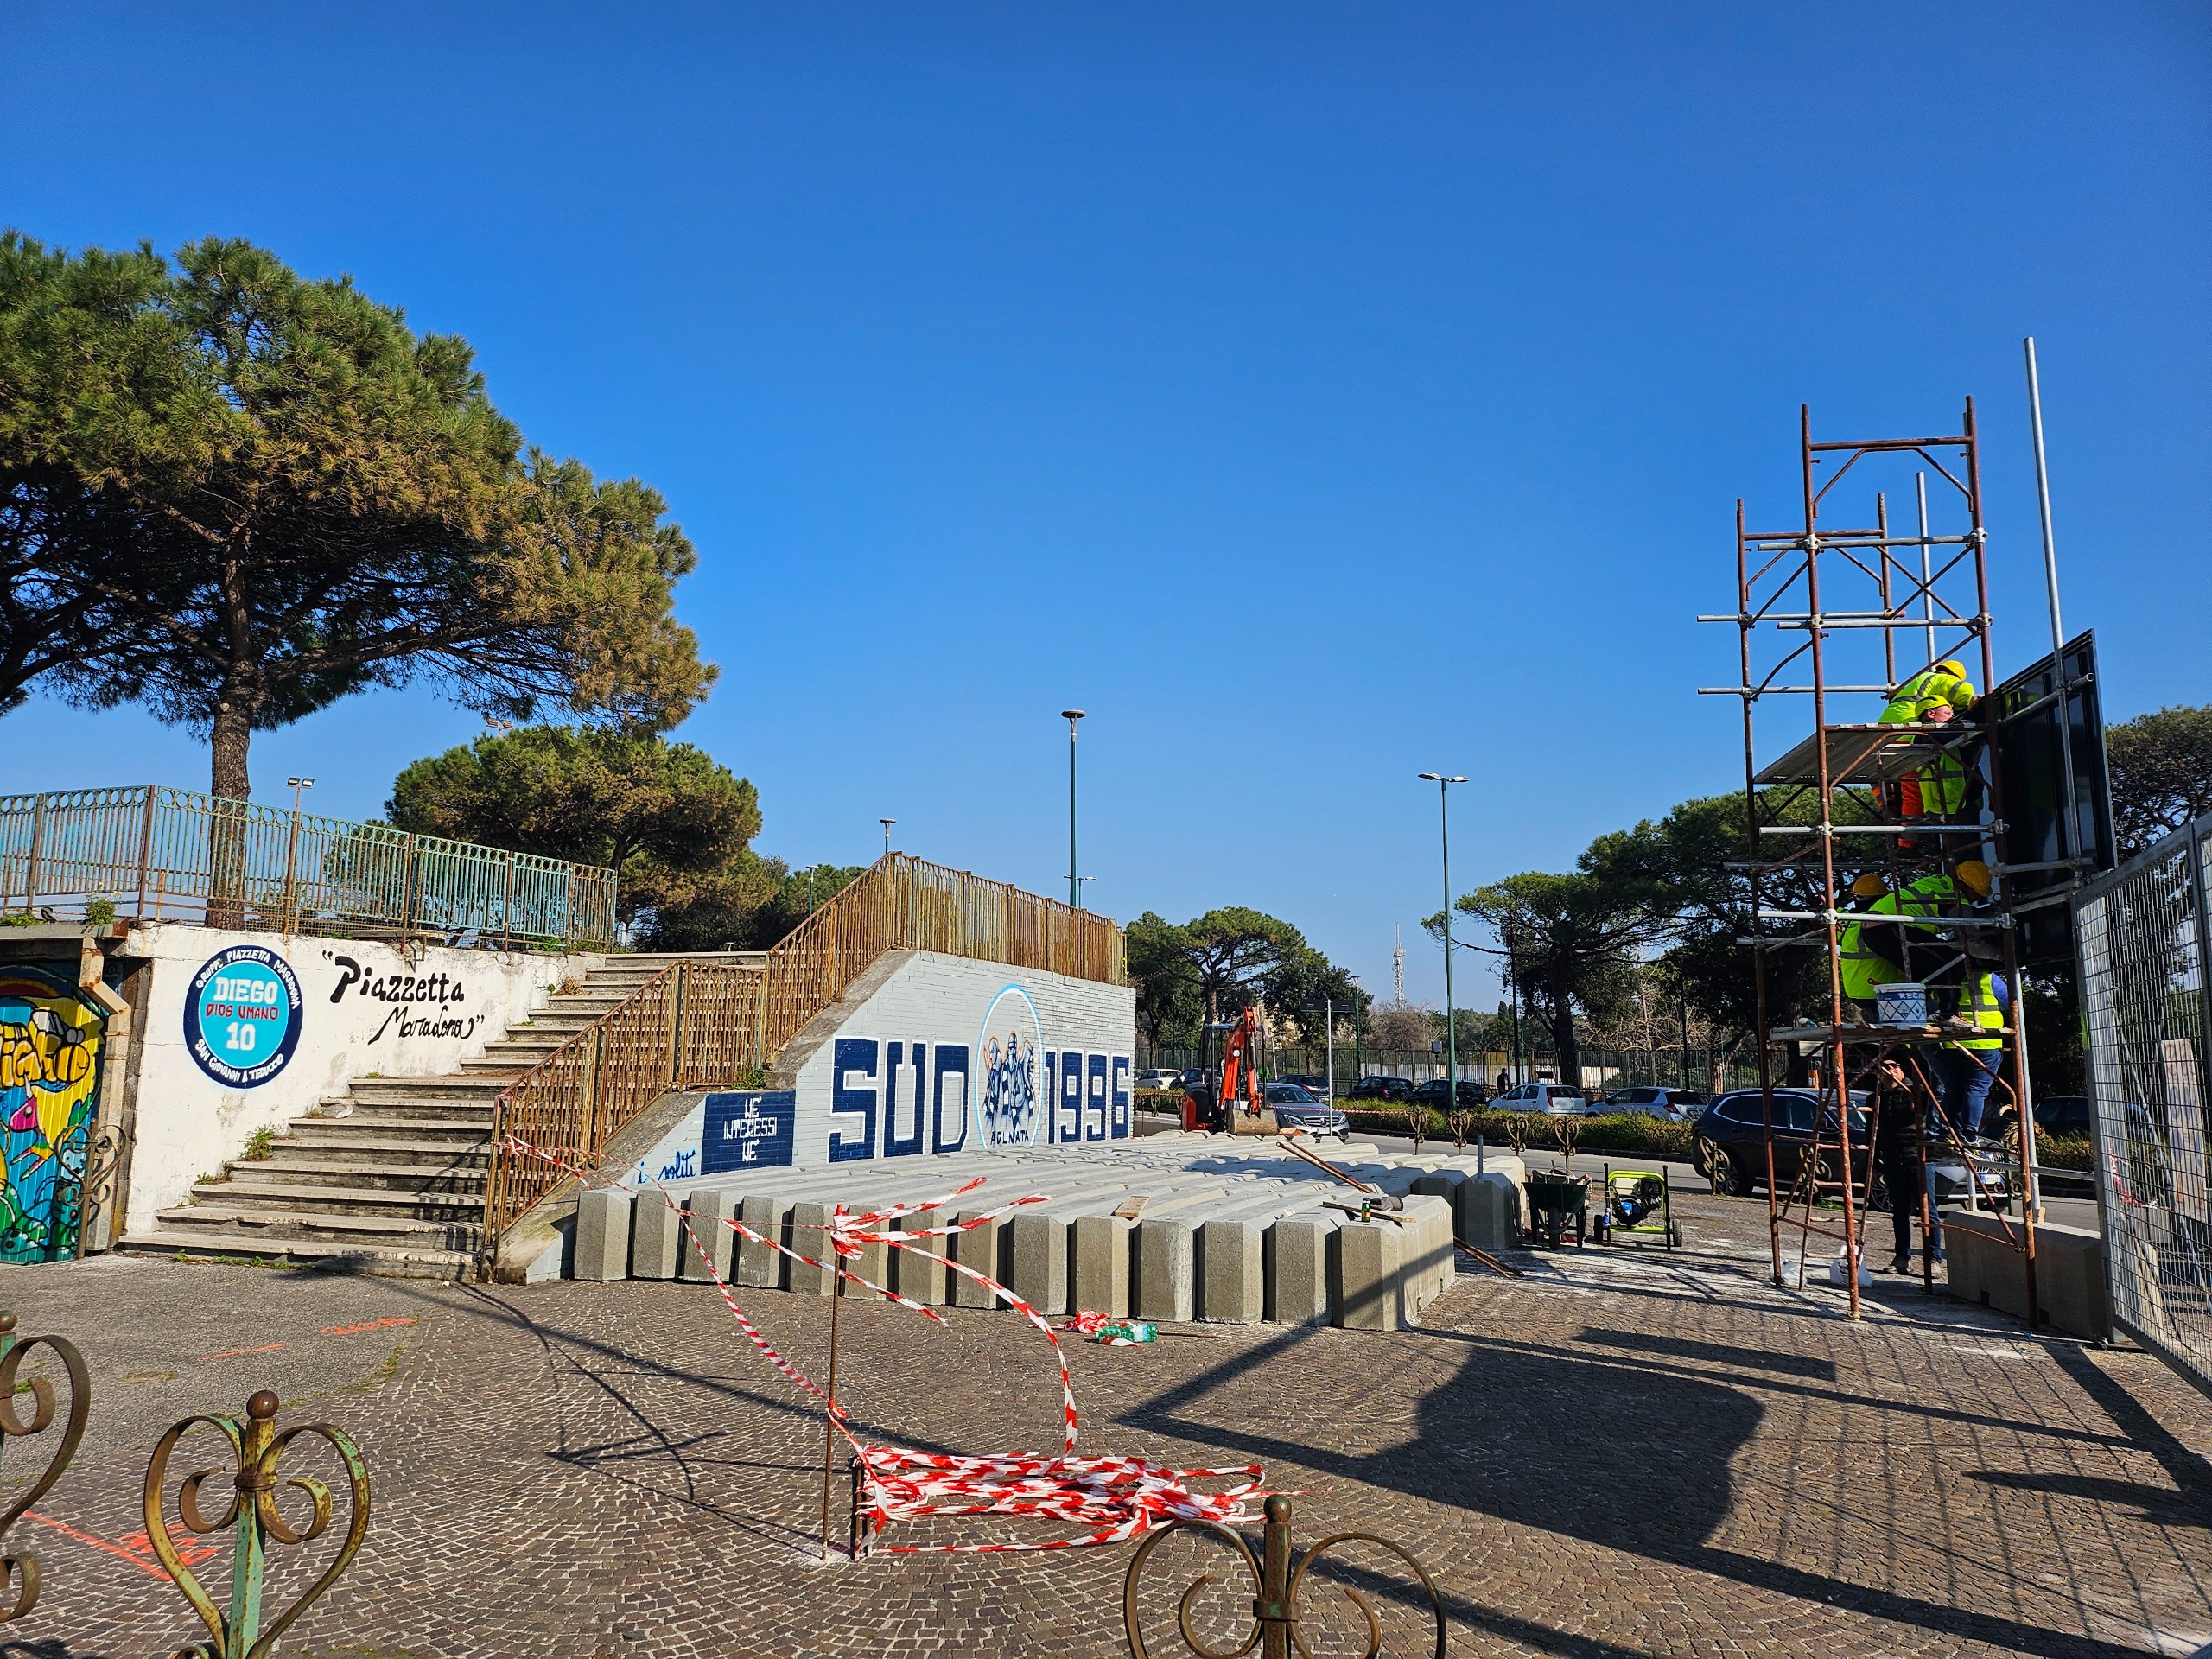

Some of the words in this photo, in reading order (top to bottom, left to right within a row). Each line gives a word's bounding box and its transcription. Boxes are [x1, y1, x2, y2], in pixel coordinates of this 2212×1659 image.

[213, 977, 278, 1005] DIEGO
[226, 949, 271, 963] PIAZZETTA
[273, 959, 302, 1010] MARADONA
[206, 1003, 233, 1018] DIOS
[238, 1006, 279, 1020] UMANO
[226, 1022, 256, 1051] 10
[194, 1039, 210, 1062] SAN
[241, 1069, 249, 1083] A
[249, 1053, 283, 1080] TEDUCCIO
[828, 1036, 971, 1163] SUD
[1043, 1047, 1131, 1146] 1996
[723, 1116, 777, 1140] INTERESSI
[990, 1129, 1029, 1145] ADUNATA
[658, 1150, 696, 1181] soliti
